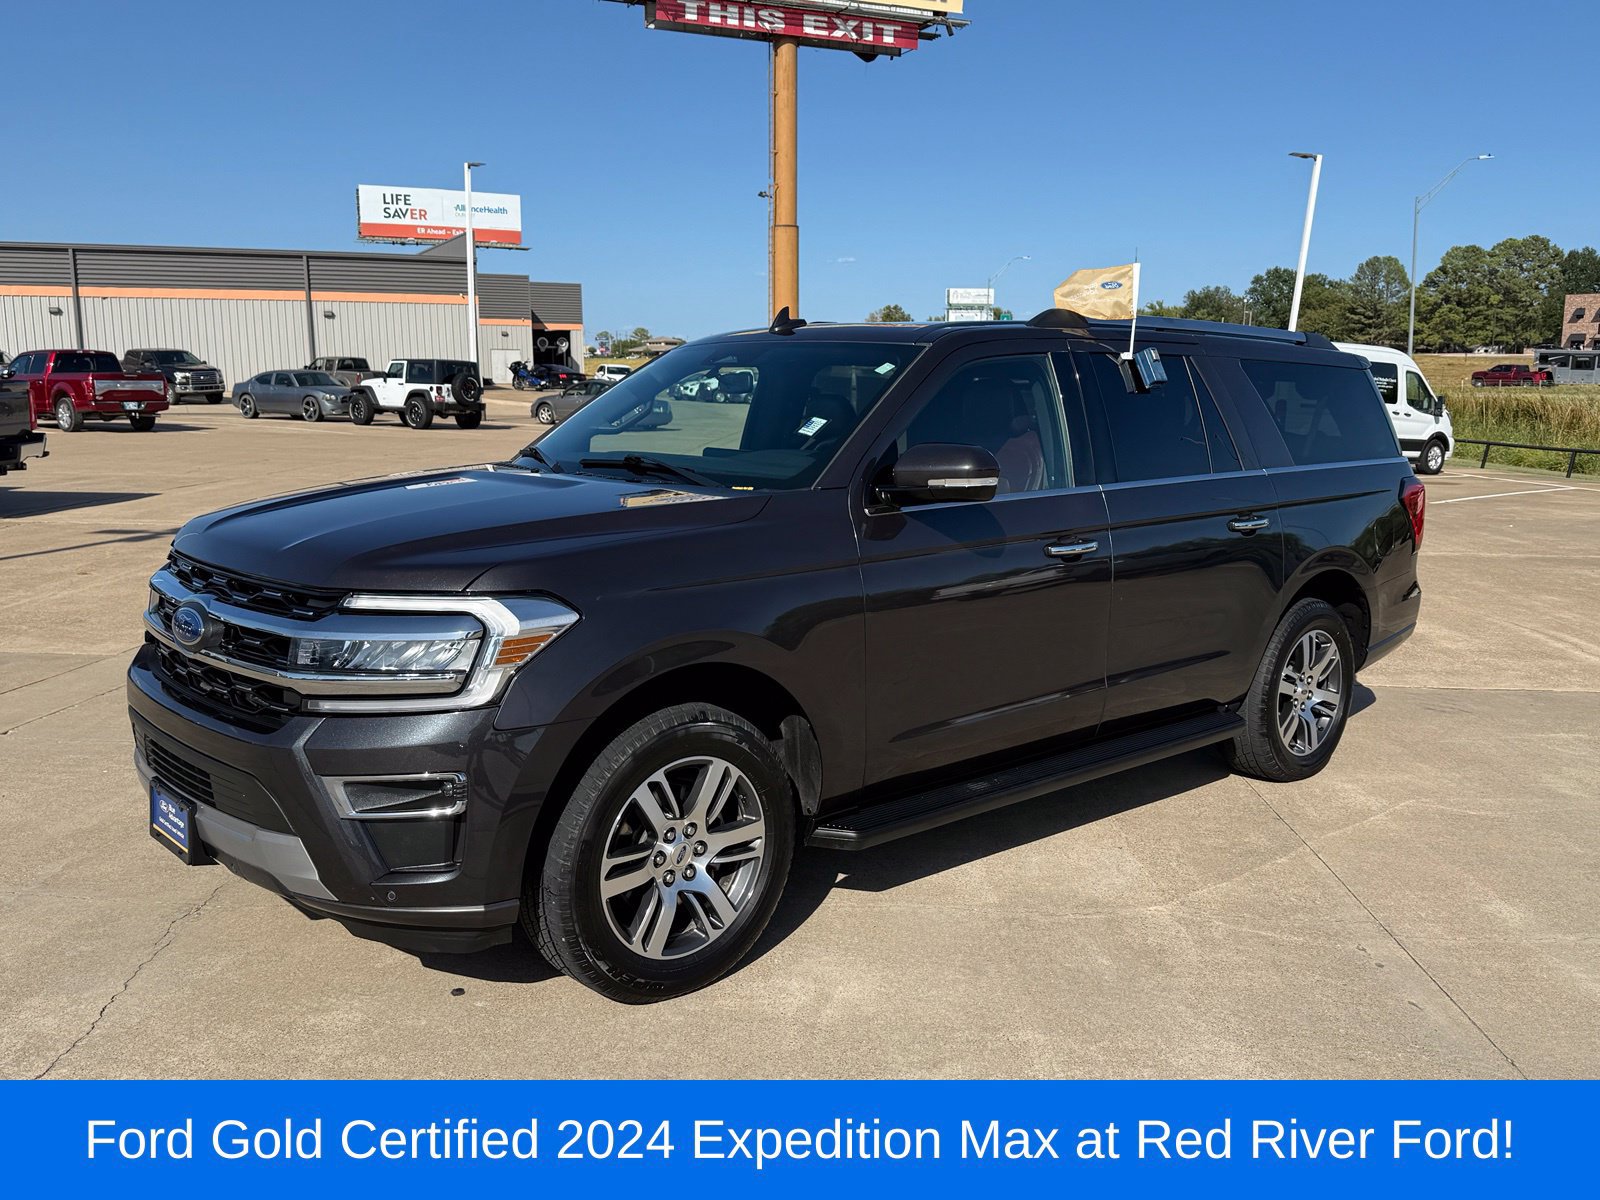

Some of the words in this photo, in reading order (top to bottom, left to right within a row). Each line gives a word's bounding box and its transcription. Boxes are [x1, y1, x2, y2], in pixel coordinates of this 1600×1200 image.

[677, 0, 785, 30] THIS
[803, 13, 901, 43] EXIT
[382, 193, 412, 206] LIFE
[383, 207, 428, 221] SAVER
[453, 204, 508, 215] AllnceHealth
